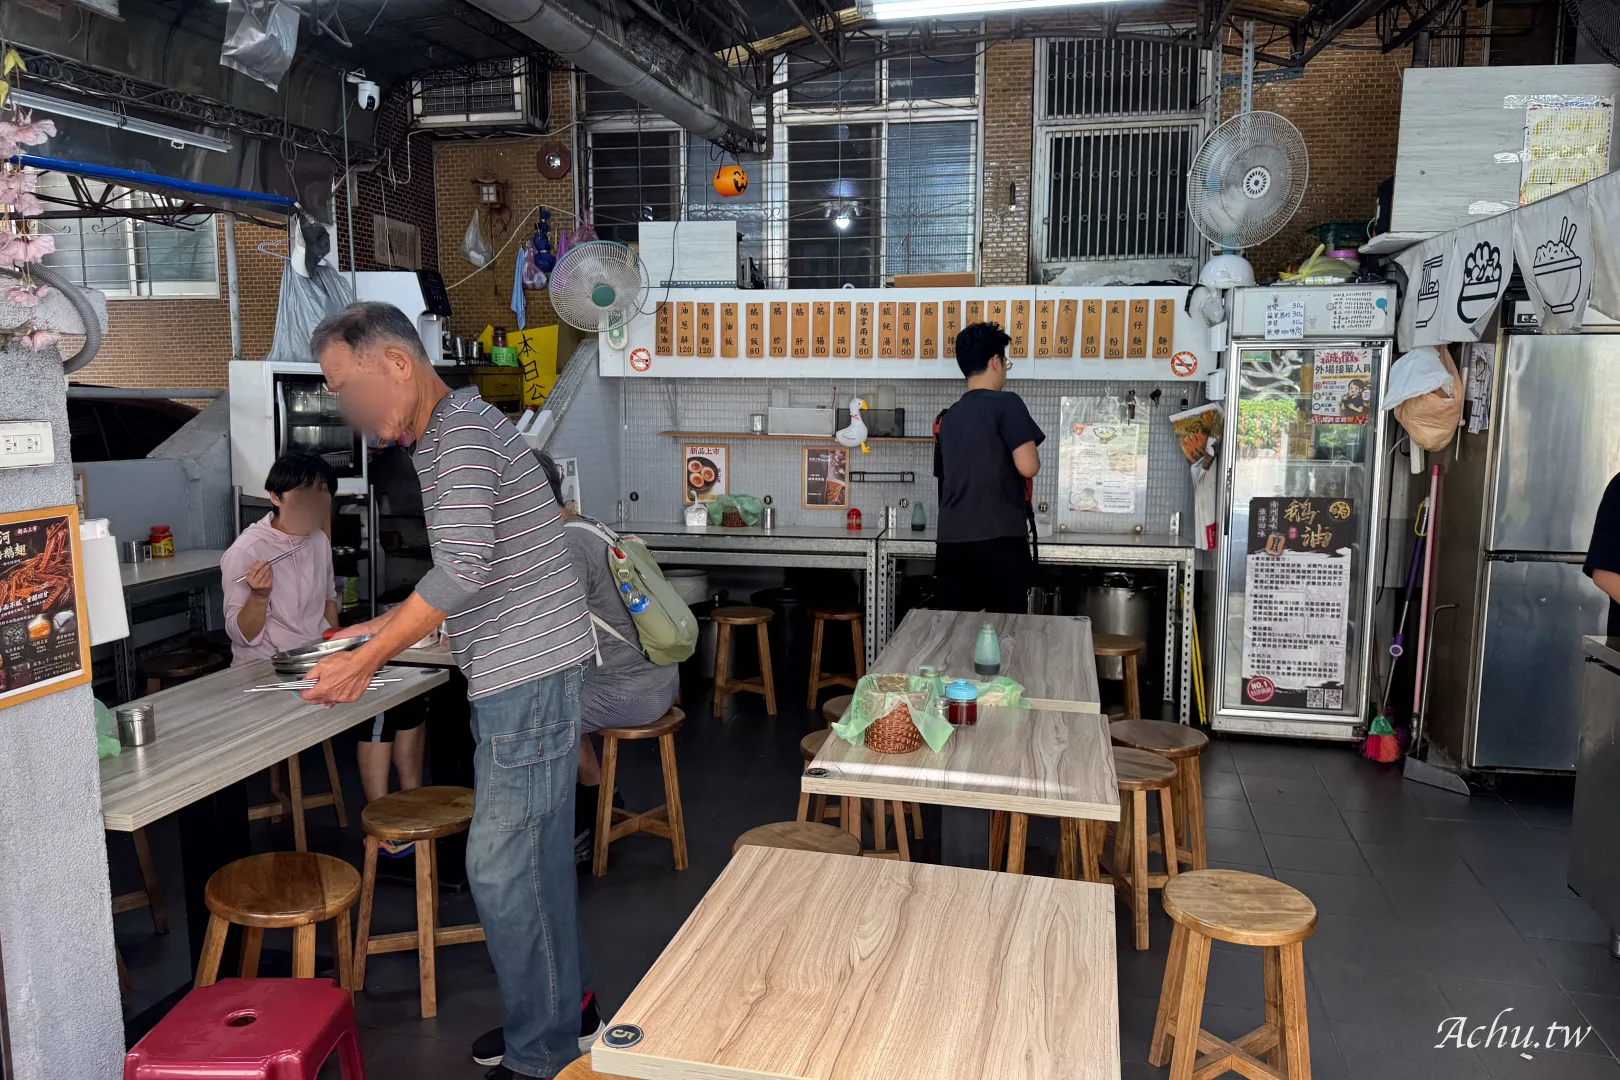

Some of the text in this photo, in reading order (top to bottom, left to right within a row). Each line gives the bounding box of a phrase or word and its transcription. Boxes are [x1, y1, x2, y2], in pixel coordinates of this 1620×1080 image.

[725, 309, 733, 346] 鵝油飯
[751, 309, 759, 346] 鵝肉飯
[796, 308, 804, 346] 鵝肝
[1040, 305, 1049, 345] 米苔目
[1059, 304, 1072, 345] 冬粉
[1109, 305, 1120, 346] 米粉
[1133, 305, 1144, 345] 切仔麵
[1158, 305, 1168, 345] 意麵
[517, 333, 547, 401] 本日公
[1315, 363, 1371, 375] 外場接單人員
[1324, 351, 1356, 364] 誠徵
[690, 447, 720, 455] 新品上市
[612, 1029, 635, 1040] 5
